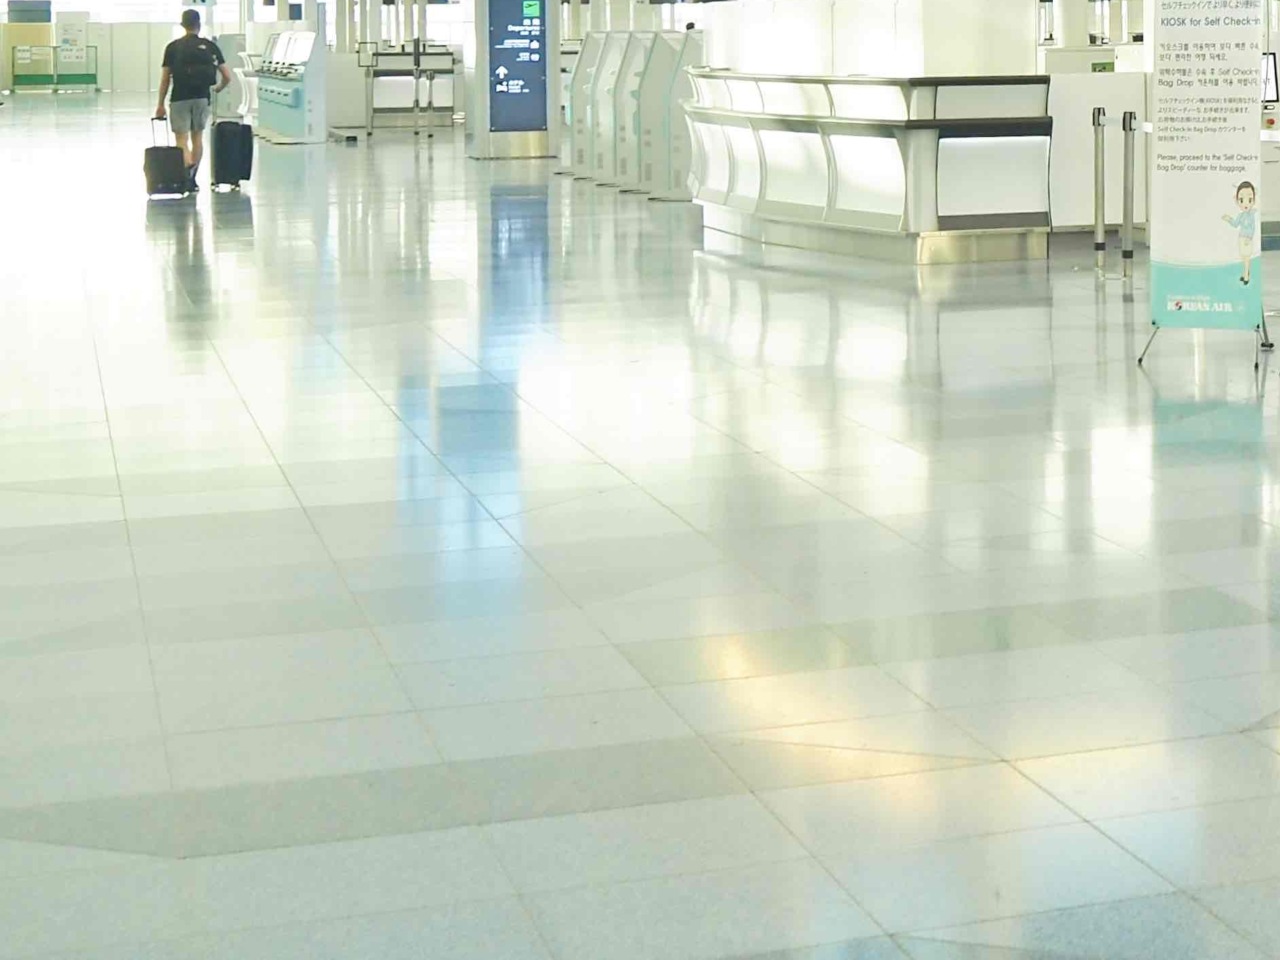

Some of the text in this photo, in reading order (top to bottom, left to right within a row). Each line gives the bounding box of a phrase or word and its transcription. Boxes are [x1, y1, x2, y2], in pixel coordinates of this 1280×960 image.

[1160, 17, 1187, 27] KIOSK
[1190, 17, 1202, 27] for
[1204, 16, 1221, 26] Self
